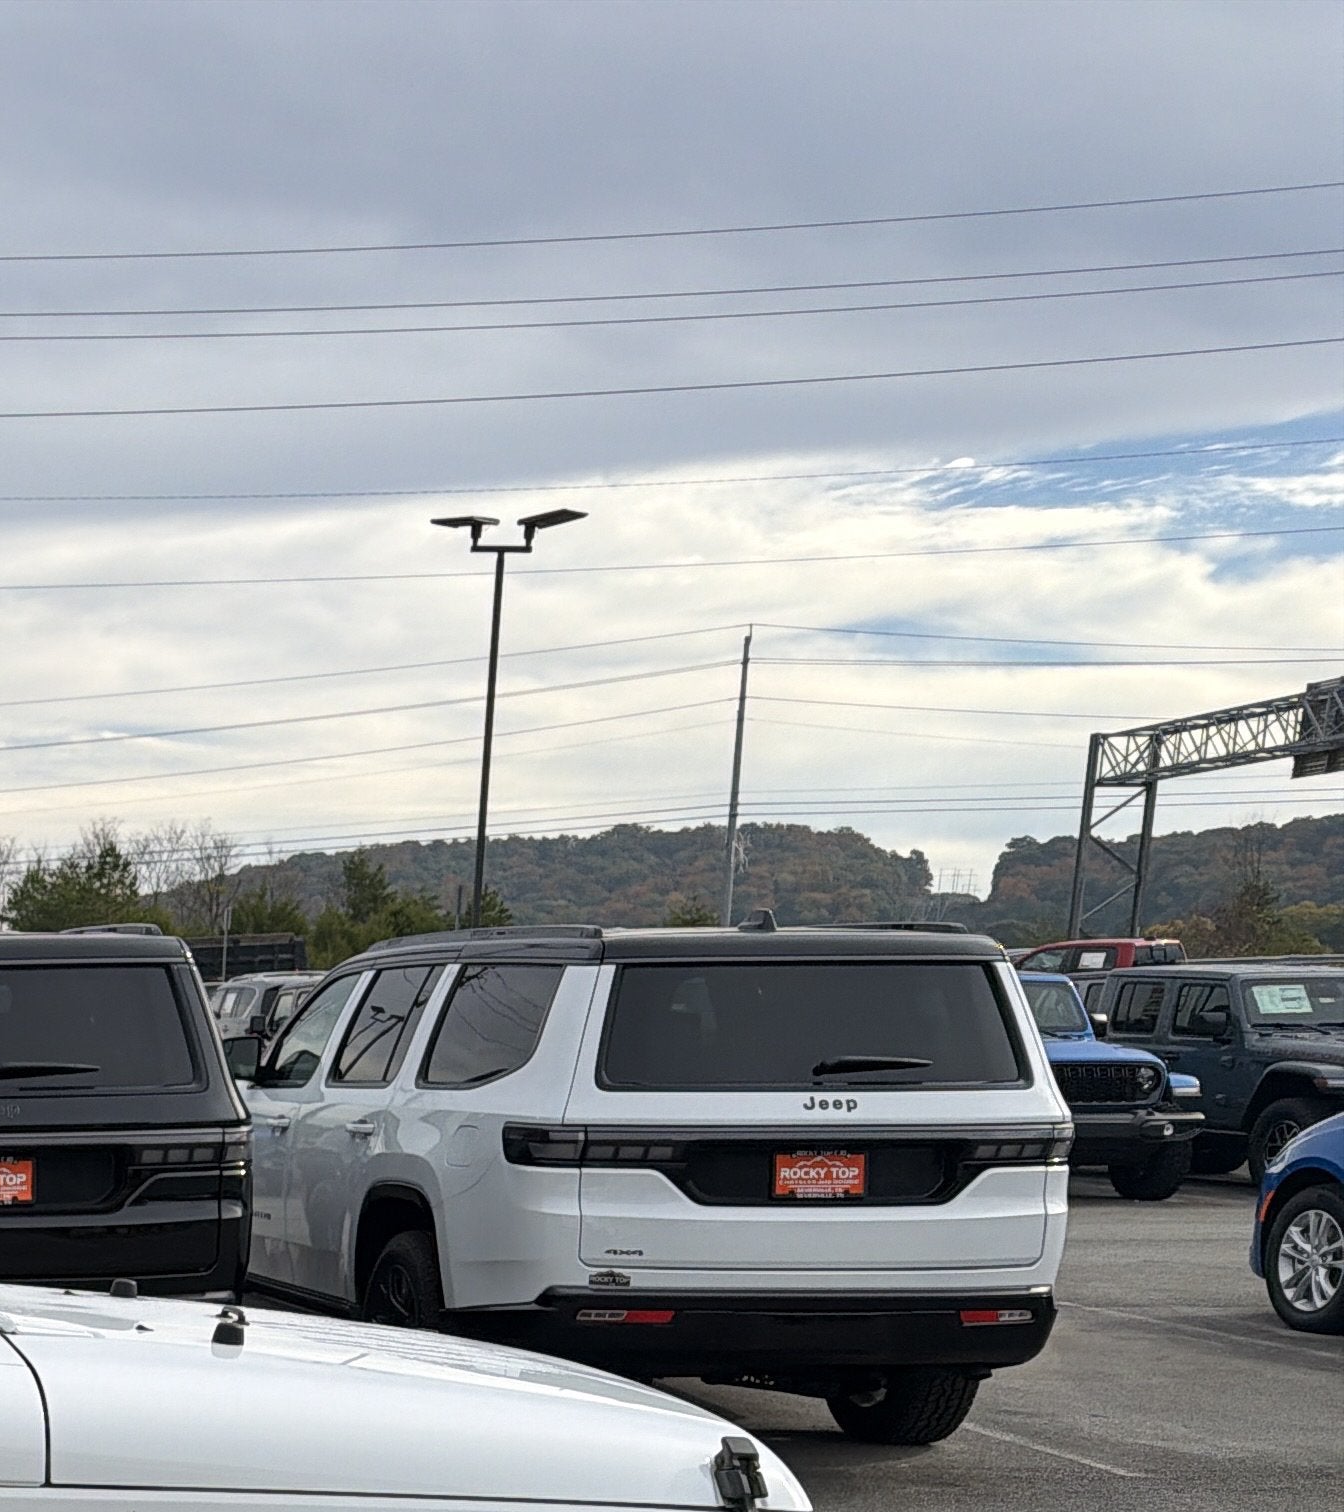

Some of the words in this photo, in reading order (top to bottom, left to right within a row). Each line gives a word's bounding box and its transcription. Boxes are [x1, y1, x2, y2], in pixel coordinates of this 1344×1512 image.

[802, 1095, 858, 1112] Jeep
[780, 1167, 827, 1179] ROCKY
[830, 1167, 859, 1179] TOP
